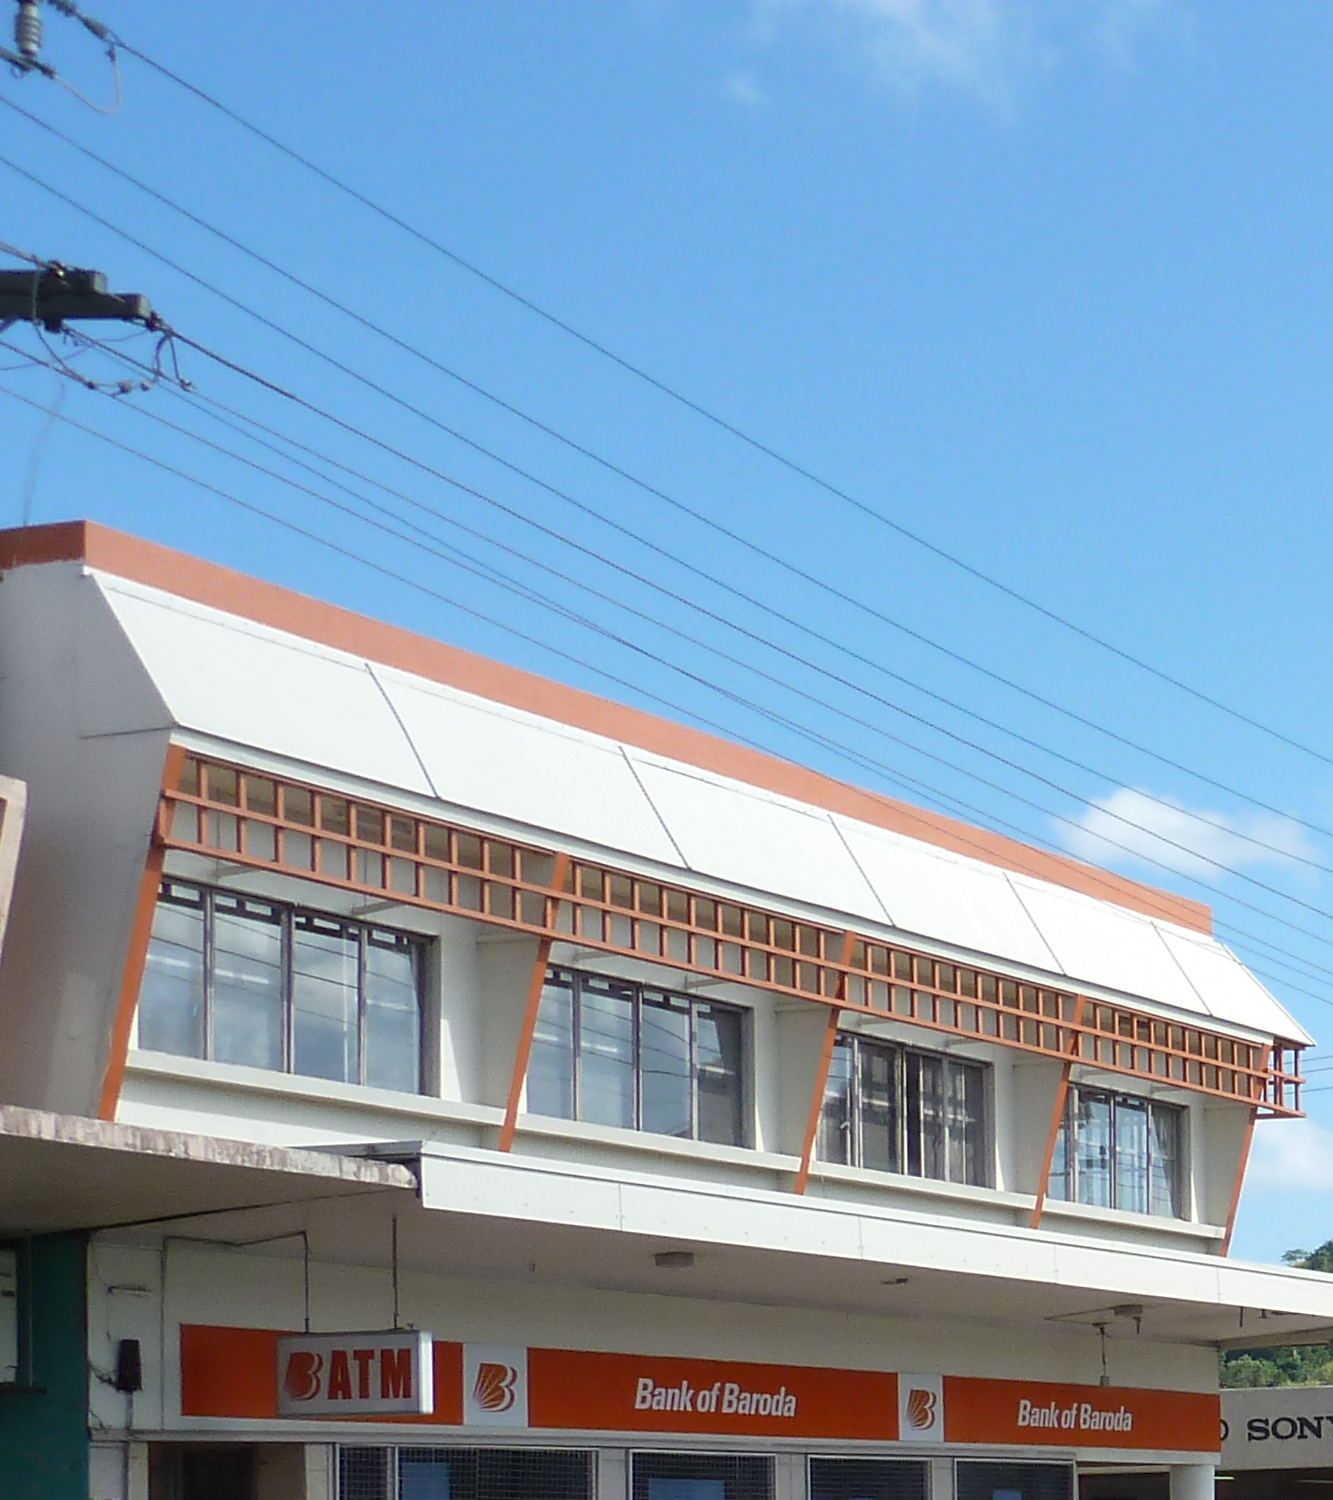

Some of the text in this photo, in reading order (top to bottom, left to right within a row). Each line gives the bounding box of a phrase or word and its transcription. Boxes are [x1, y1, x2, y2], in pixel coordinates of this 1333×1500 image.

[327, 1348, 412, 1400] ATM
[634, 1377, 797, 1417] Bank of Baroda
[1018, 1399, 1133, 1431] Bank of Baroda
